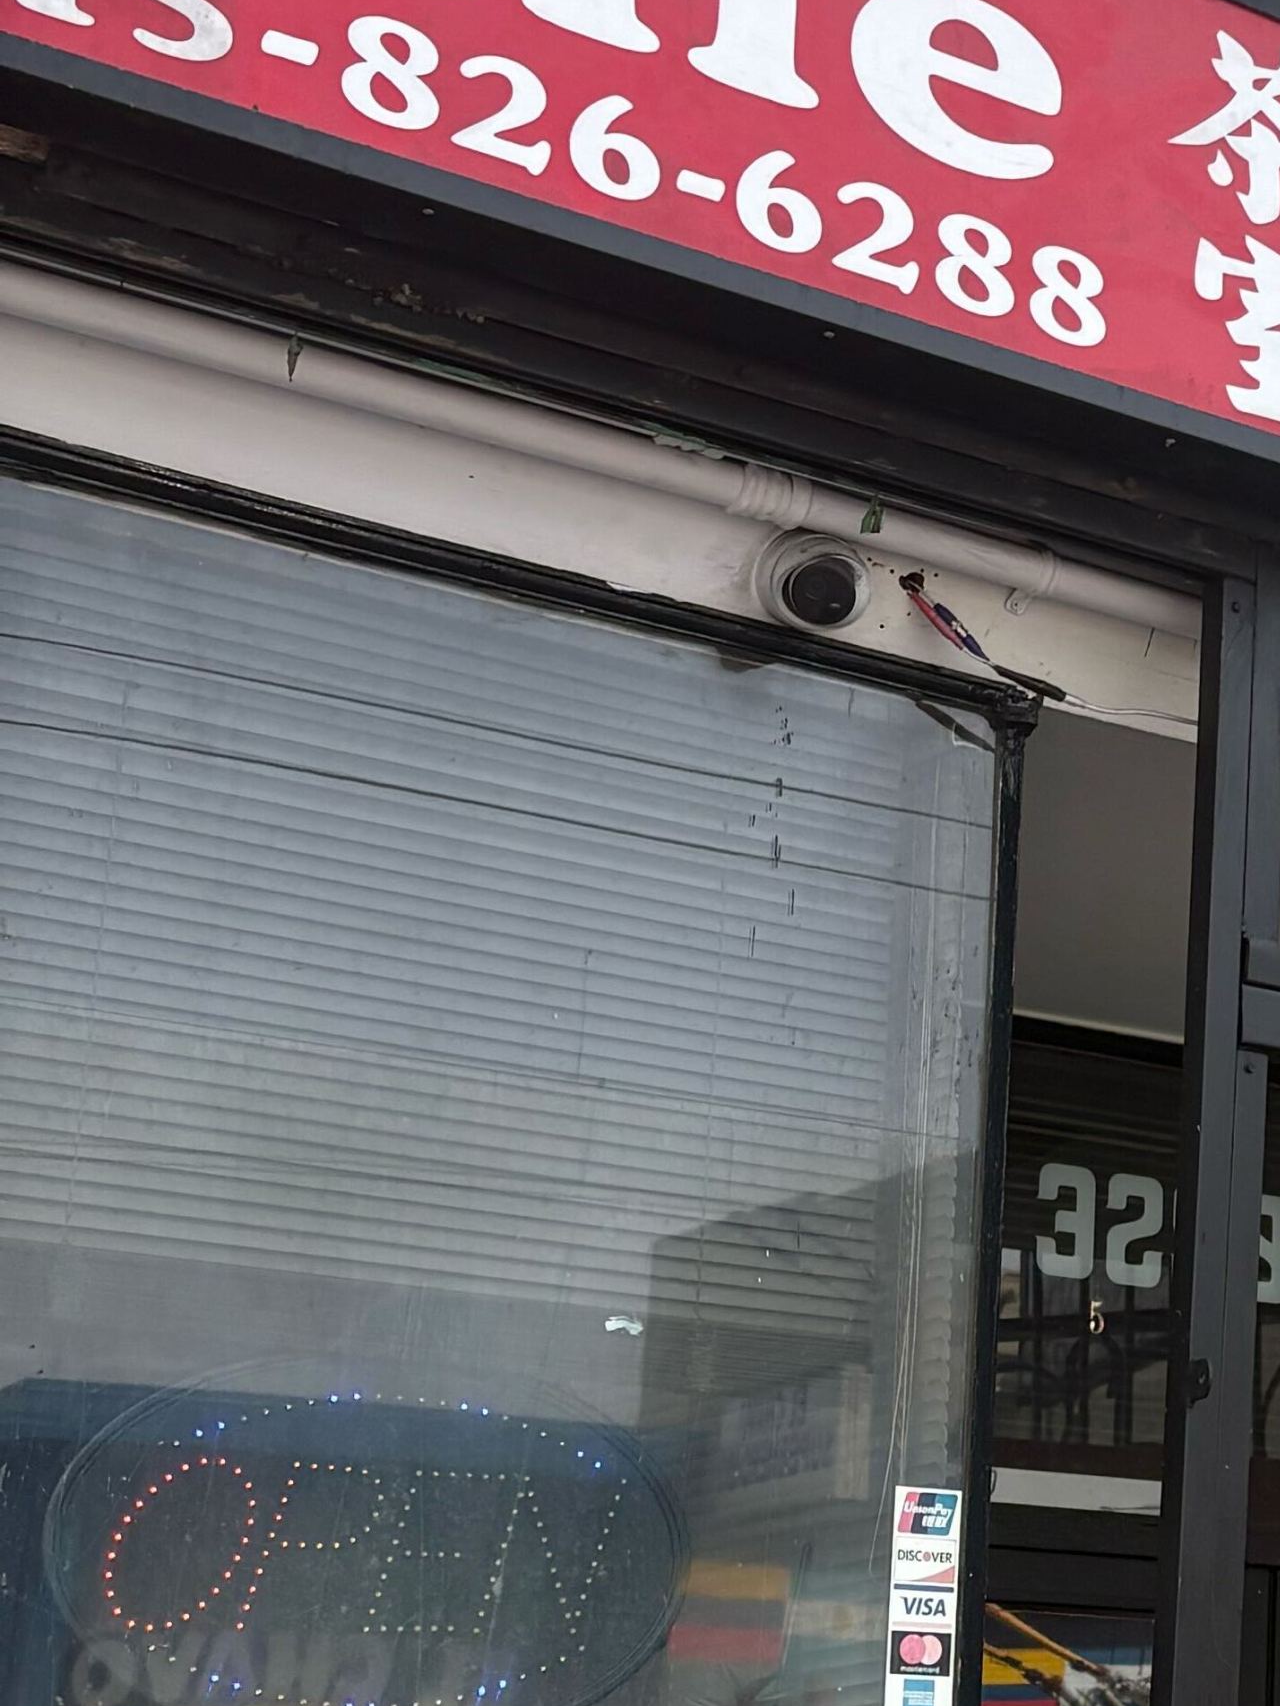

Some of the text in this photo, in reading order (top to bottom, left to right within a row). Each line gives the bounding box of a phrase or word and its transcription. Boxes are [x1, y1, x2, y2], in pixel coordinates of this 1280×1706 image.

[104, 1458, 627, 1632] OPEN
[897, 1548, 952, 1564] DISCOVER
[900, 1596, 946, 1617] VISA
